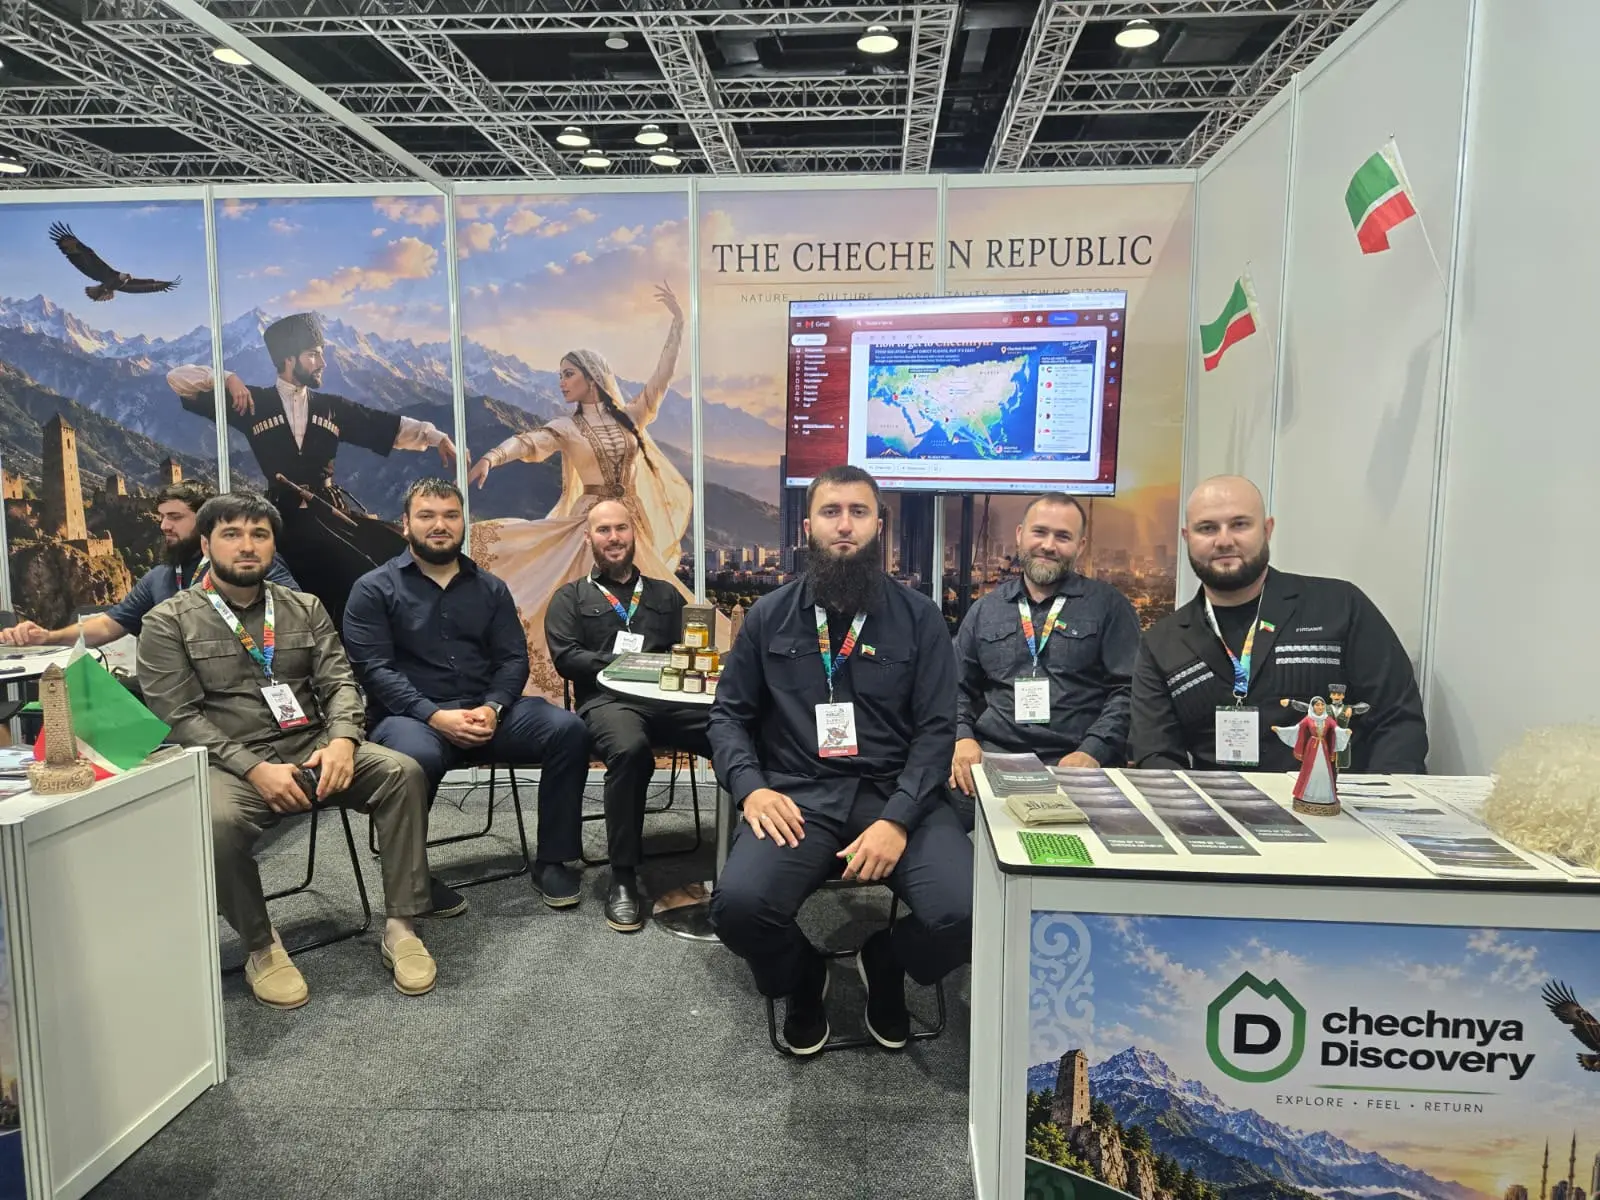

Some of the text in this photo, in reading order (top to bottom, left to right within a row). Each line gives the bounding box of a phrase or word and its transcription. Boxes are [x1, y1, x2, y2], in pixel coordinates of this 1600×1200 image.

[711, 235, 1153, 272] THE CHECHEN REPUBLIC
[741, 293, 789, 302] NATURE
[817, 292, 873, 301] CULTURE
[815, 320, 830, 328] Gmail
[1233, 1013, 1282, 1055] D
[1321, 1006, 1524, 1047] chechnya
[1320, 1041, 1536, 1081] Discovery
[1275, 1094, 1484, 1113] EXPLORE FEEL RETURN
